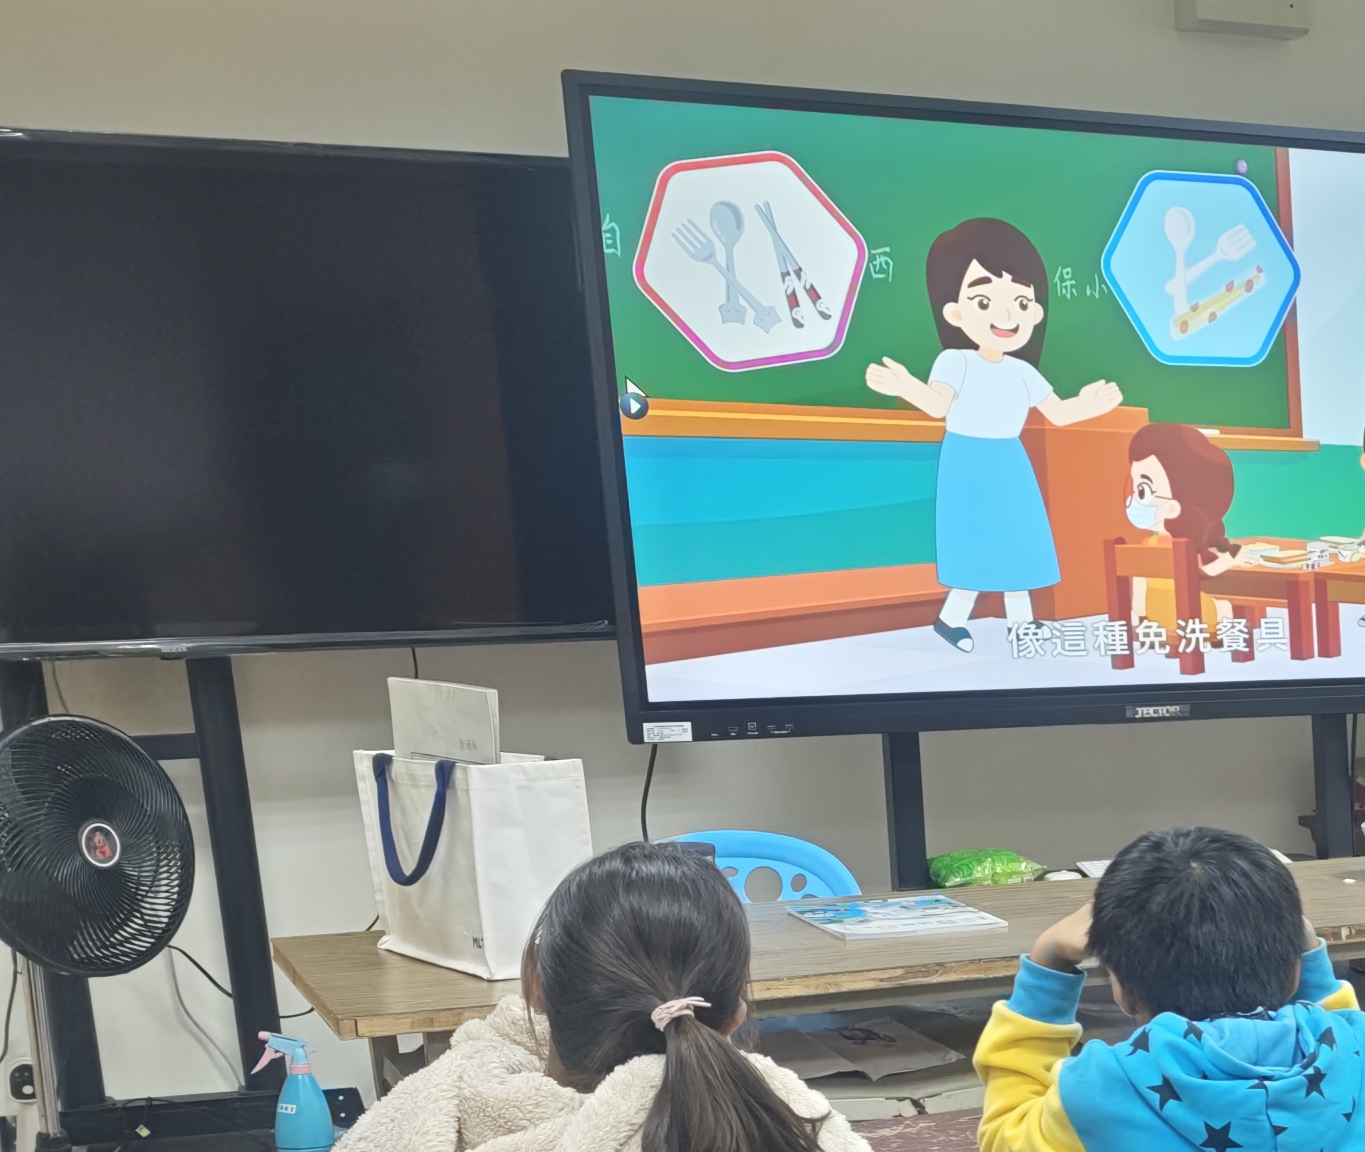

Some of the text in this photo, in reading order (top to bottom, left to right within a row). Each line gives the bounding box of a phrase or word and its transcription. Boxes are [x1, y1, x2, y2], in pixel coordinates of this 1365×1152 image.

[1008, 616, 1290, 659] 像這種免洗餐具
